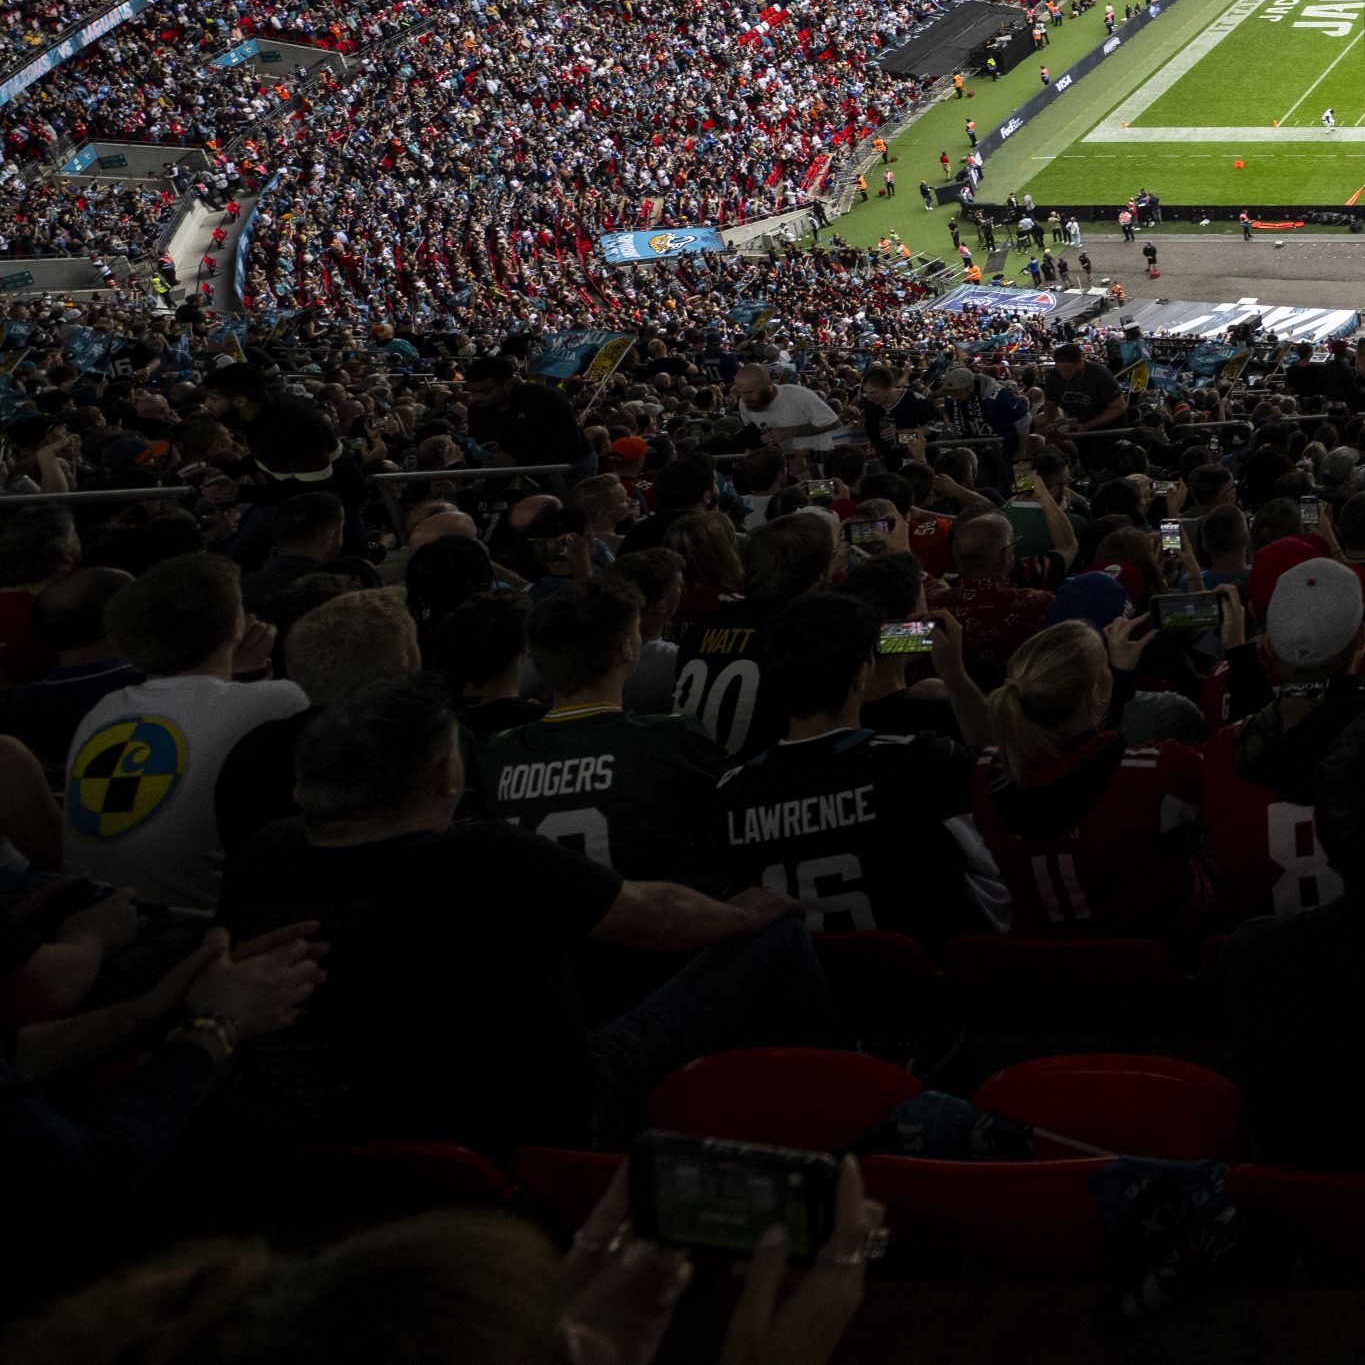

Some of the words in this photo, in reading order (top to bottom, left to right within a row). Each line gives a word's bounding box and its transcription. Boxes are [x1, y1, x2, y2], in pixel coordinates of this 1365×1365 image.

[1055, 74, 1073, 92] VISA
[699, 627, 755, 657] WATT
[498, 753, 616, 802] RODGERS
[728, 784, 877, 847] LAWRENCE
[1029, 853, 1093, 923] 11
